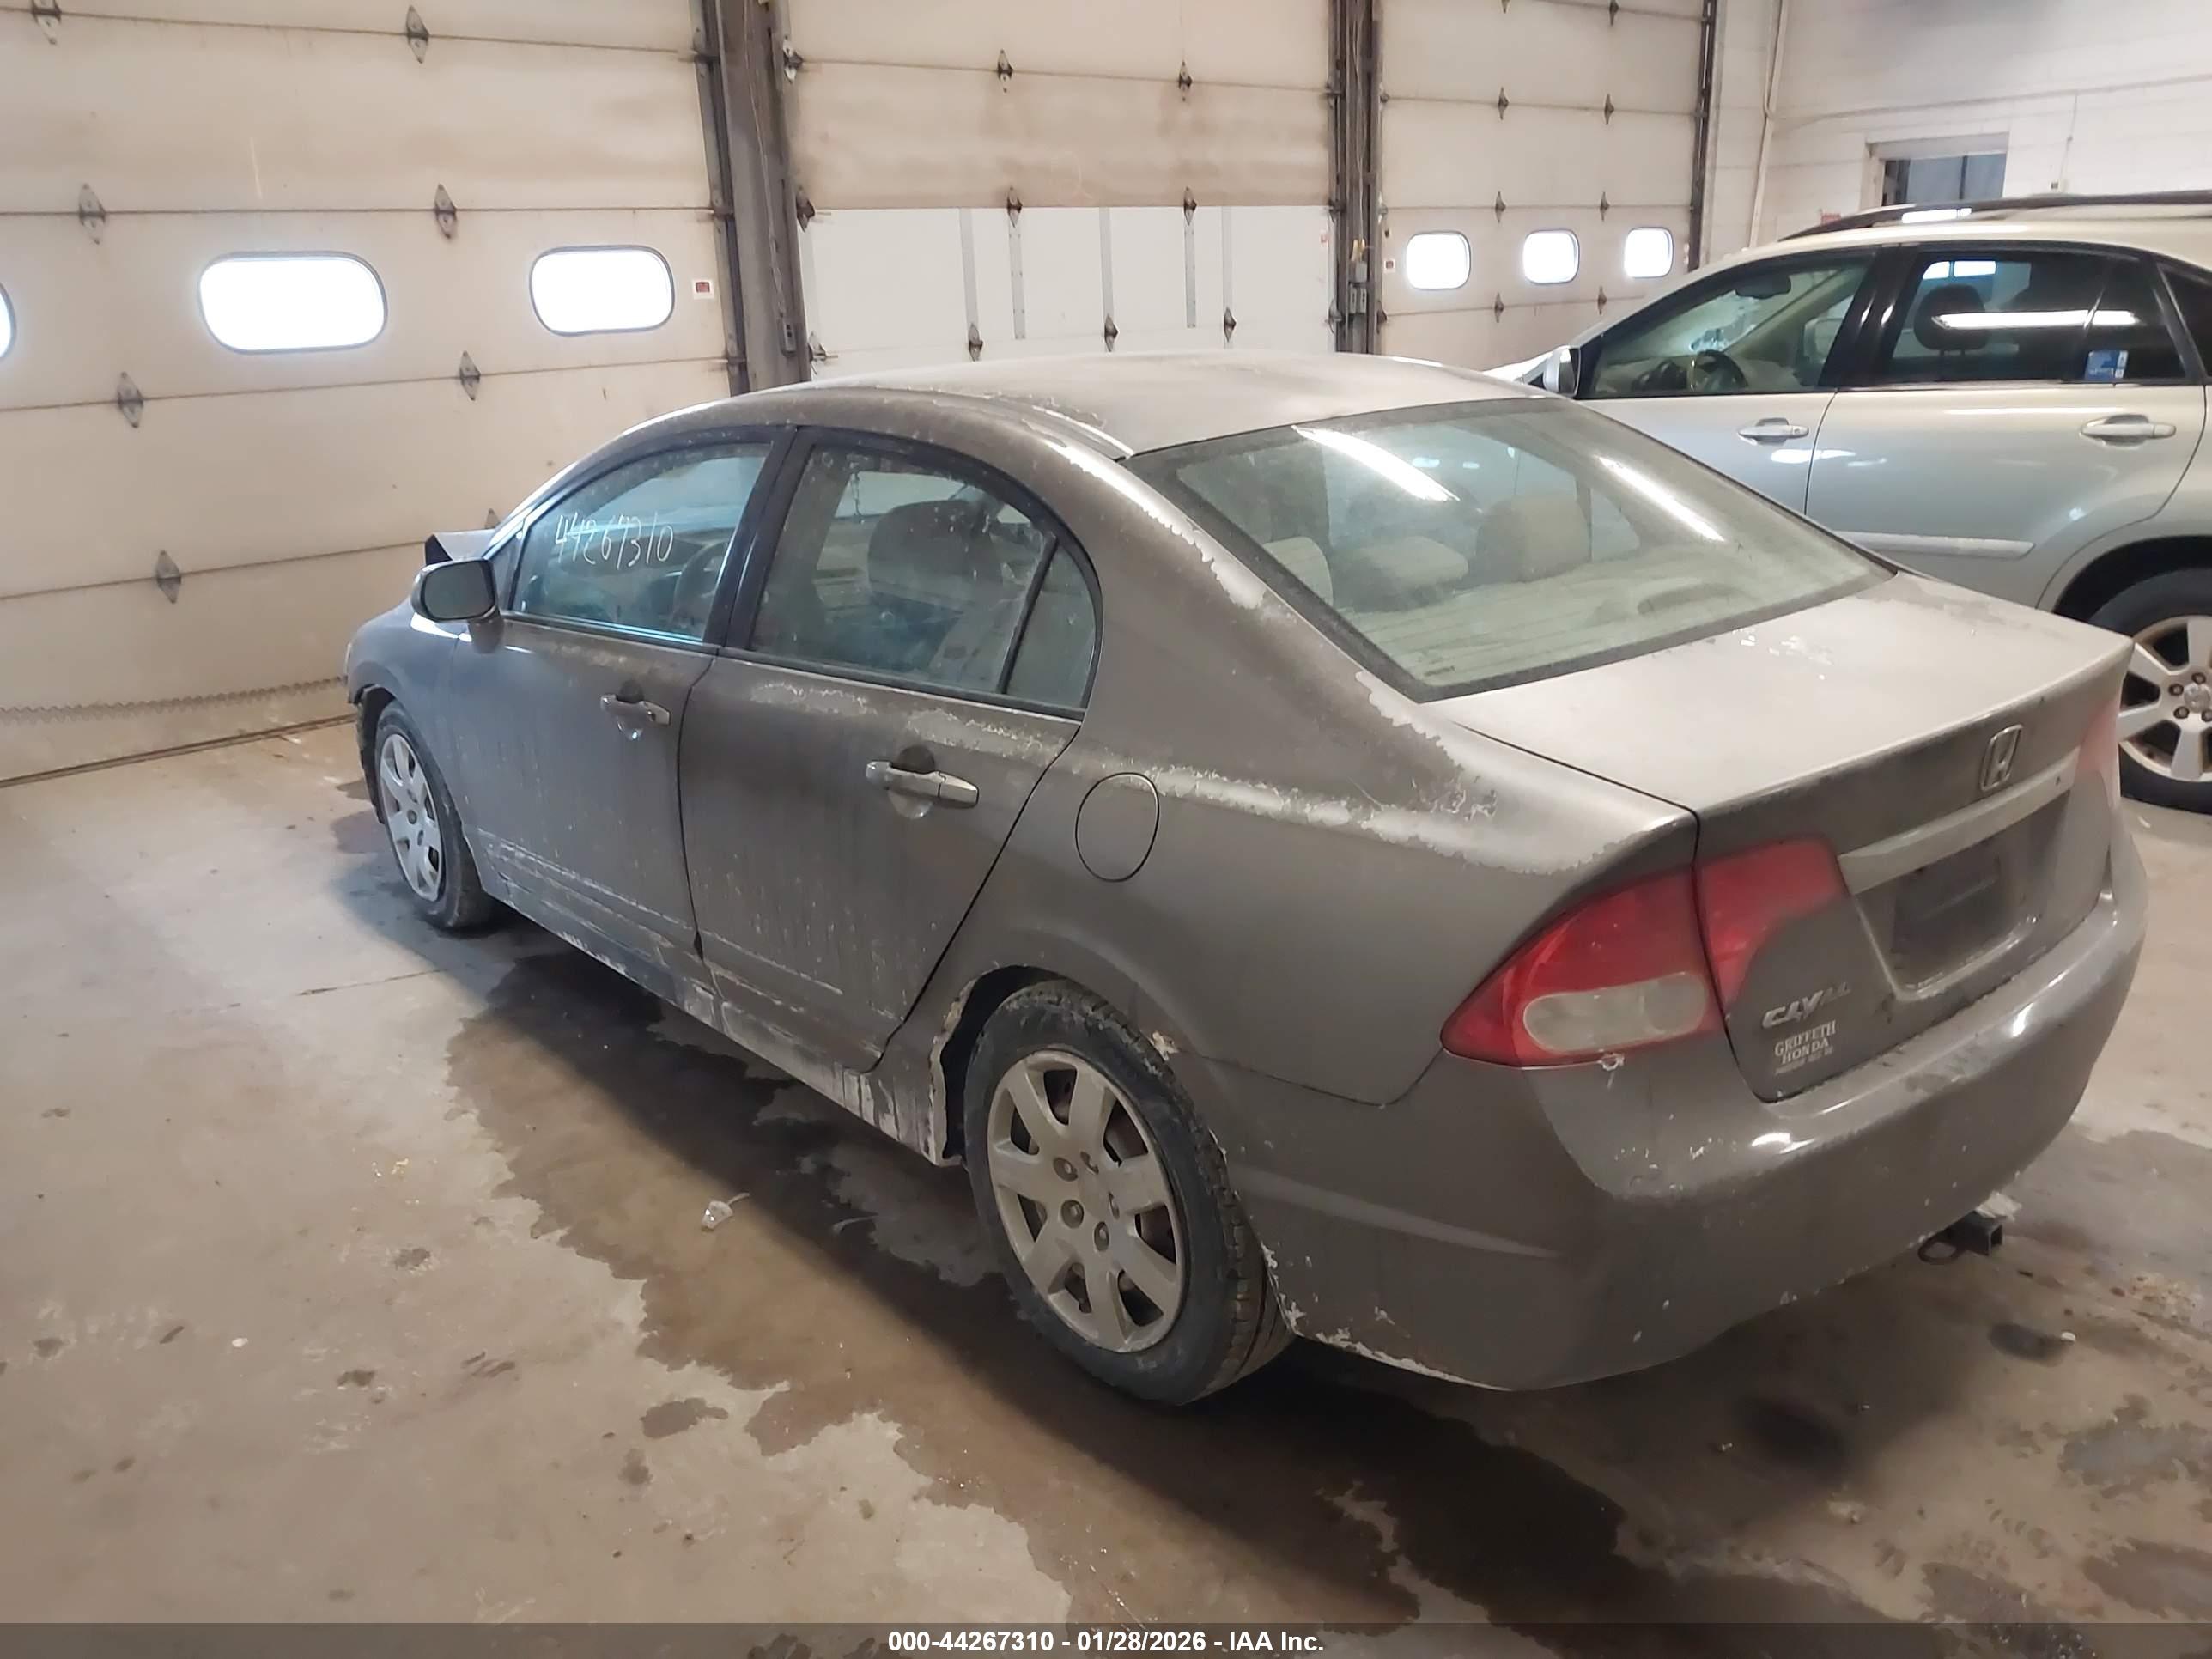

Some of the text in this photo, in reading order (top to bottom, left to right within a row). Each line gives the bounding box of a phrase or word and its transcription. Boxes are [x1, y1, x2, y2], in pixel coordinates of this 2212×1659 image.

[554, 511, 675, 570] 44267310
[1774, 1019, 1837, 1057] GRIFFETH
[1781, 1037, 1830, 1065] HONDA
